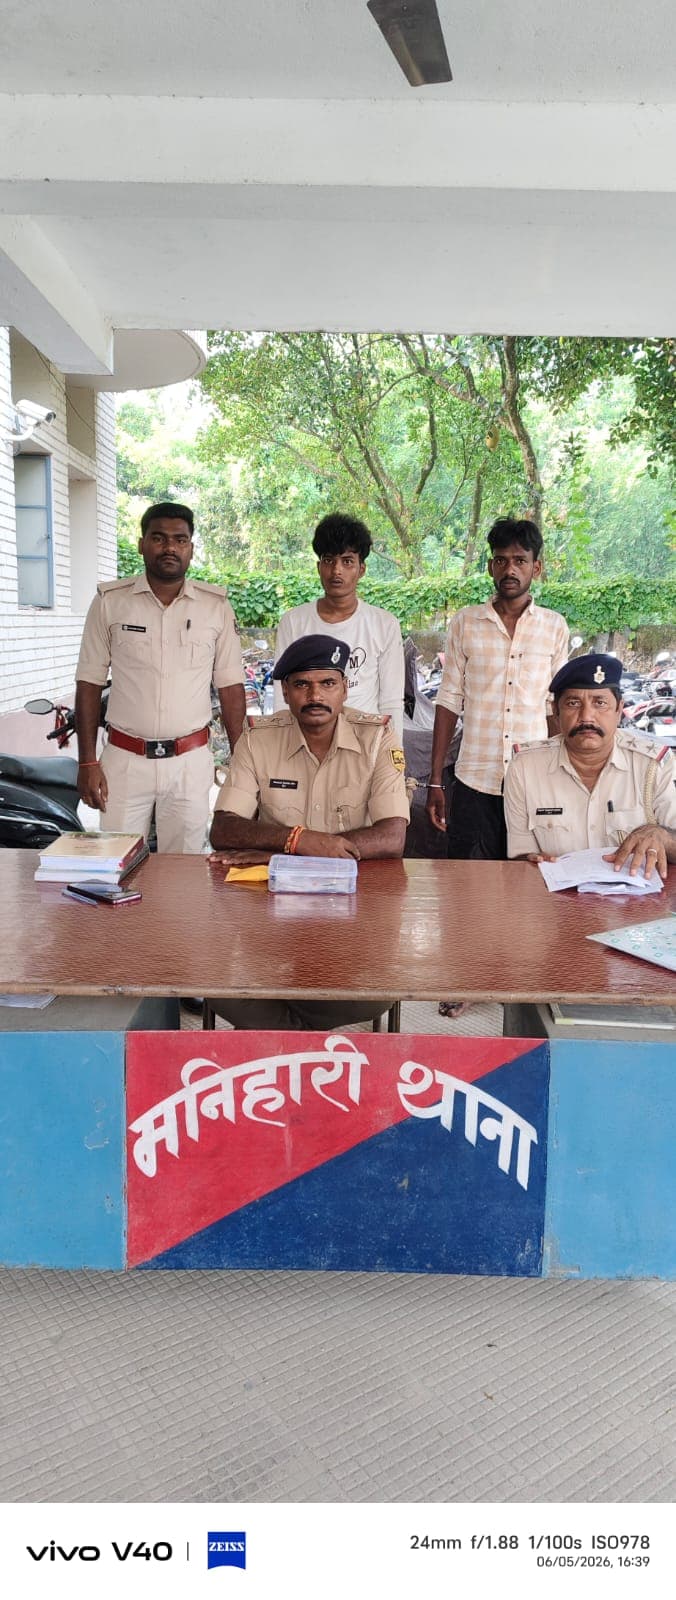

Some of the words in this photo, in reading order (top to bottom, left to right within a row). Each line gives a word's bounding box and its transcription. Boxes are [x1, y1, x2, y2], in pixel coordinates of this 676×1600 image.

[350, 656, 359, 669] M
[128, 1035, 370, 1178] मनिहारी
[397, 1060, 538, 1191] थाना
